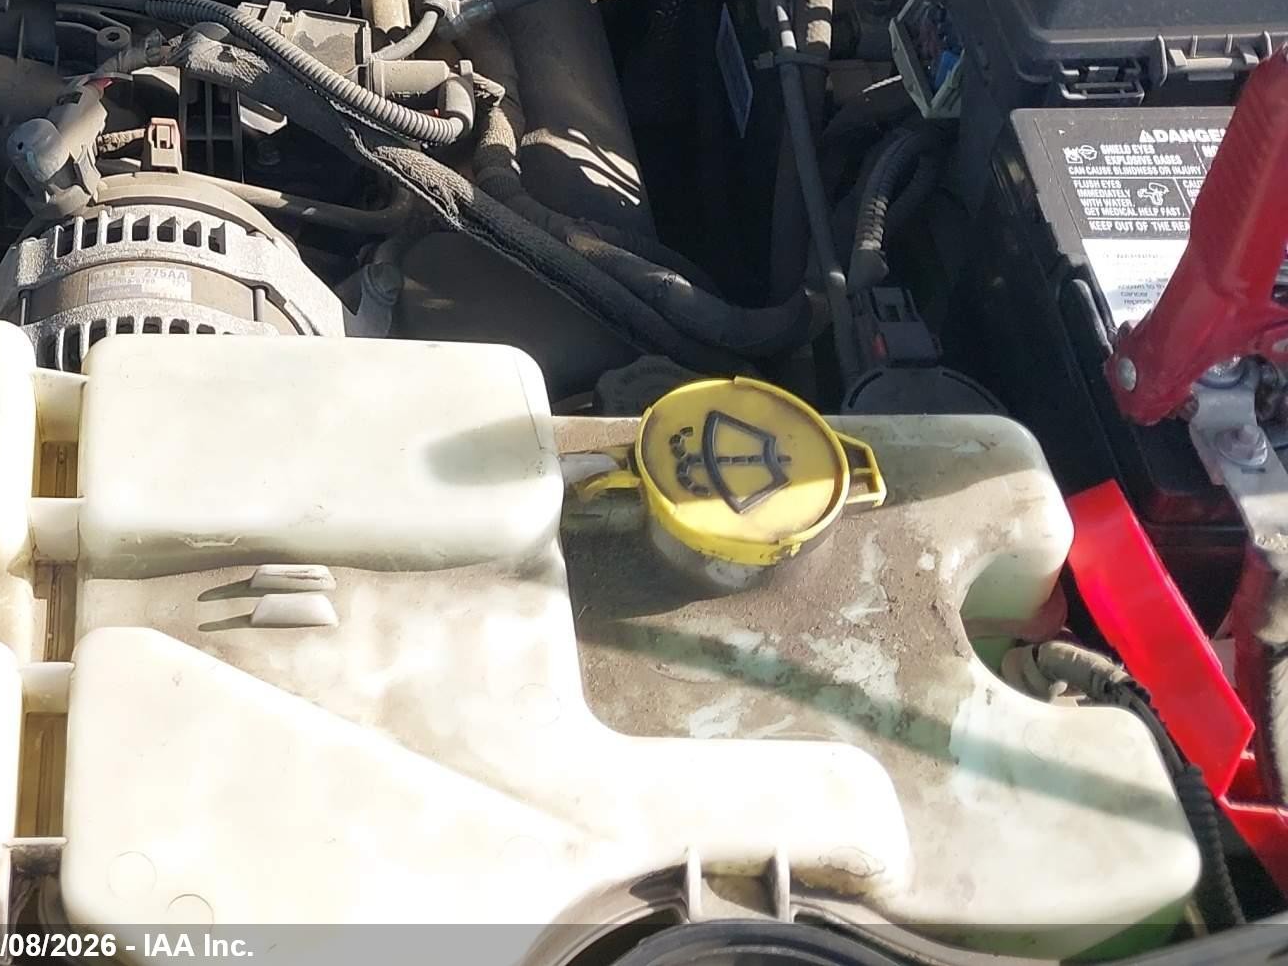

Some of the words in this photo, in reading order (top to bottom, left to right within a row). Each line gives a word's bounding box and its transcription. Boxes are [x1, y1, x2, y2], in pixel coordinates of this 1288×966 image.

[1100, 145, 1131, 154] SHIELD
[1132, 145, 1155, 154] EYES
[1105, 156, 1153, 165] EXPLOSIVE
[1154, 156, 1182, 165] GASES
[1069, 167, 1086, 175] CAN
[1086, 167, 1113, 175] CAUSE
[1115, 167, 1158, 175] BLINDNESS
[1159, 167, 1172, 175] OR
[1173, 166, 1202, 175] INJURY
[1073, 180, 1101, 188] FLUSH
[1102, 180, 1122, 188] EYES
[1077, 189, 1131, 198] IMMEDIATELY
[1080, 199, 1102, 207] WITH
[1085, 208, 1100, 216] GET
[1102, 208, 1138, 216] MEDICAL
[1140, 208, 1158, 216] HELP
[1089, 221, 1112, 231] KEEP
[1115, 221, 1134, 231] OUT
[1136, 221, 1149, 231] OF
[1151, 221, 1172, 231] THE
